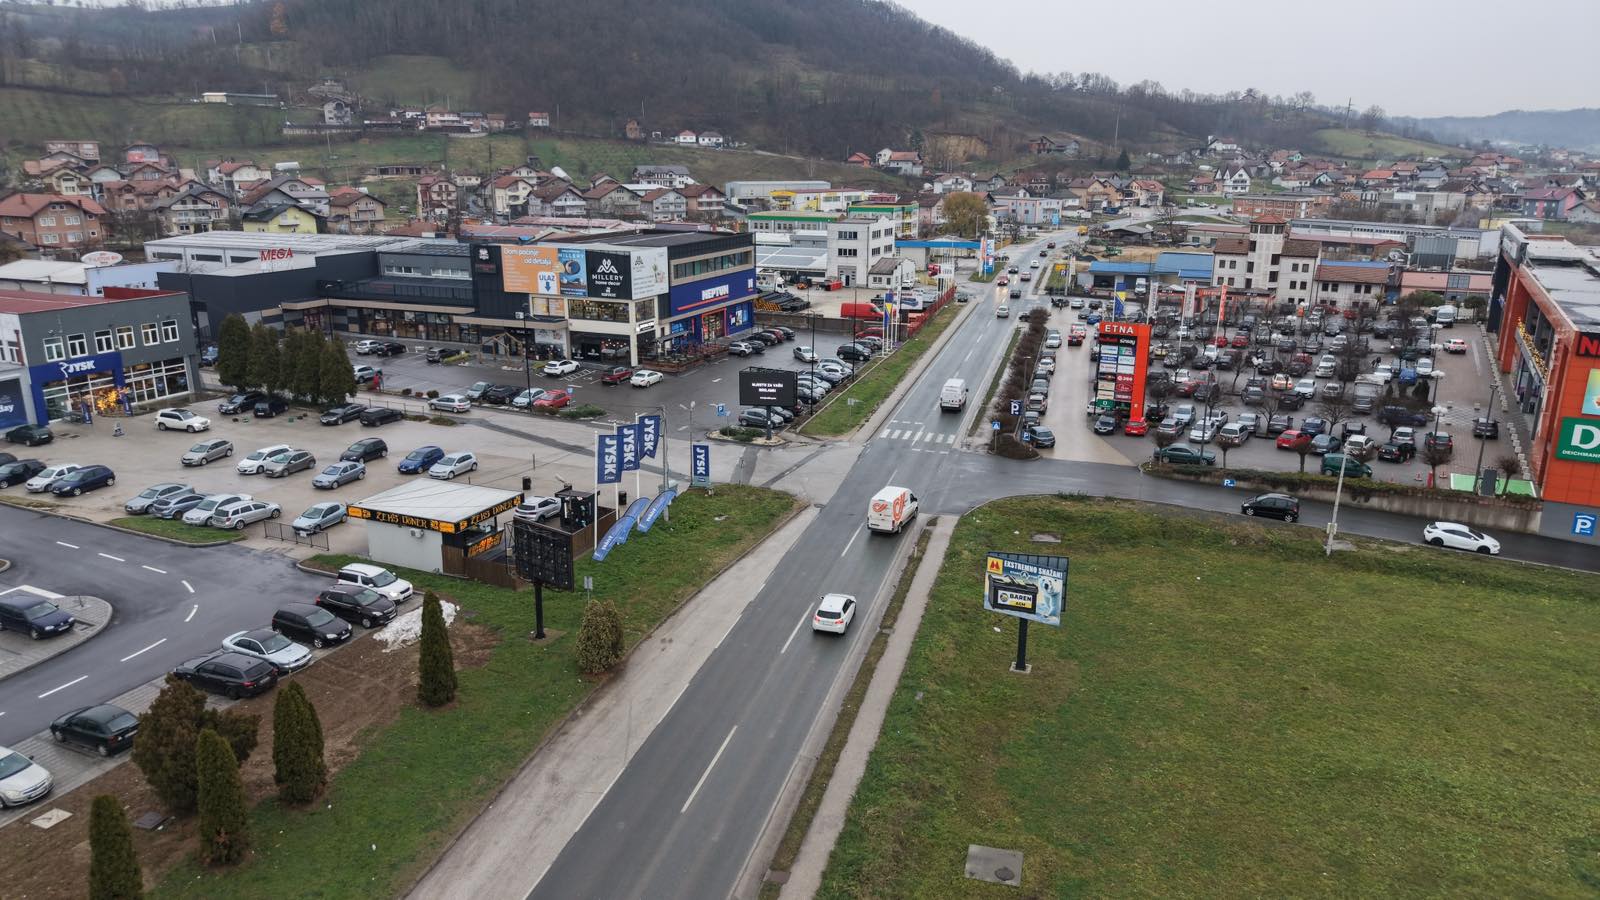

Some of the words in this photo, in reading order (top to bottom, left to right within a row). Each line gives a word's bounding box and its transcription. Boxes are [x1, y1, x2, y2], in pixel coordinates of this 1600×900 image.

[260, 248, 293, 261] MEGA
[702, 284, 729, 300] NEPTUN
[1105, 325, 1134, 334] ETNA
[1580, 336, 1600, 354] N
[68, 360, 96, 373] JYSK
[1011, 401, 1019, 414] P
[644, 418, 655, 451] JYSK
[1571, 424, 1600, 449] D
[623, 428, 635, 463] JYSK
[604, 438, 617, 477] JYSK
[697, 447, 705, 475] JYSK
[1575, 519, 1591, 533] P
[1004, 560, 1037, 574] EKSTREMNO
[1010, 593, 1032, 601] BAREN
